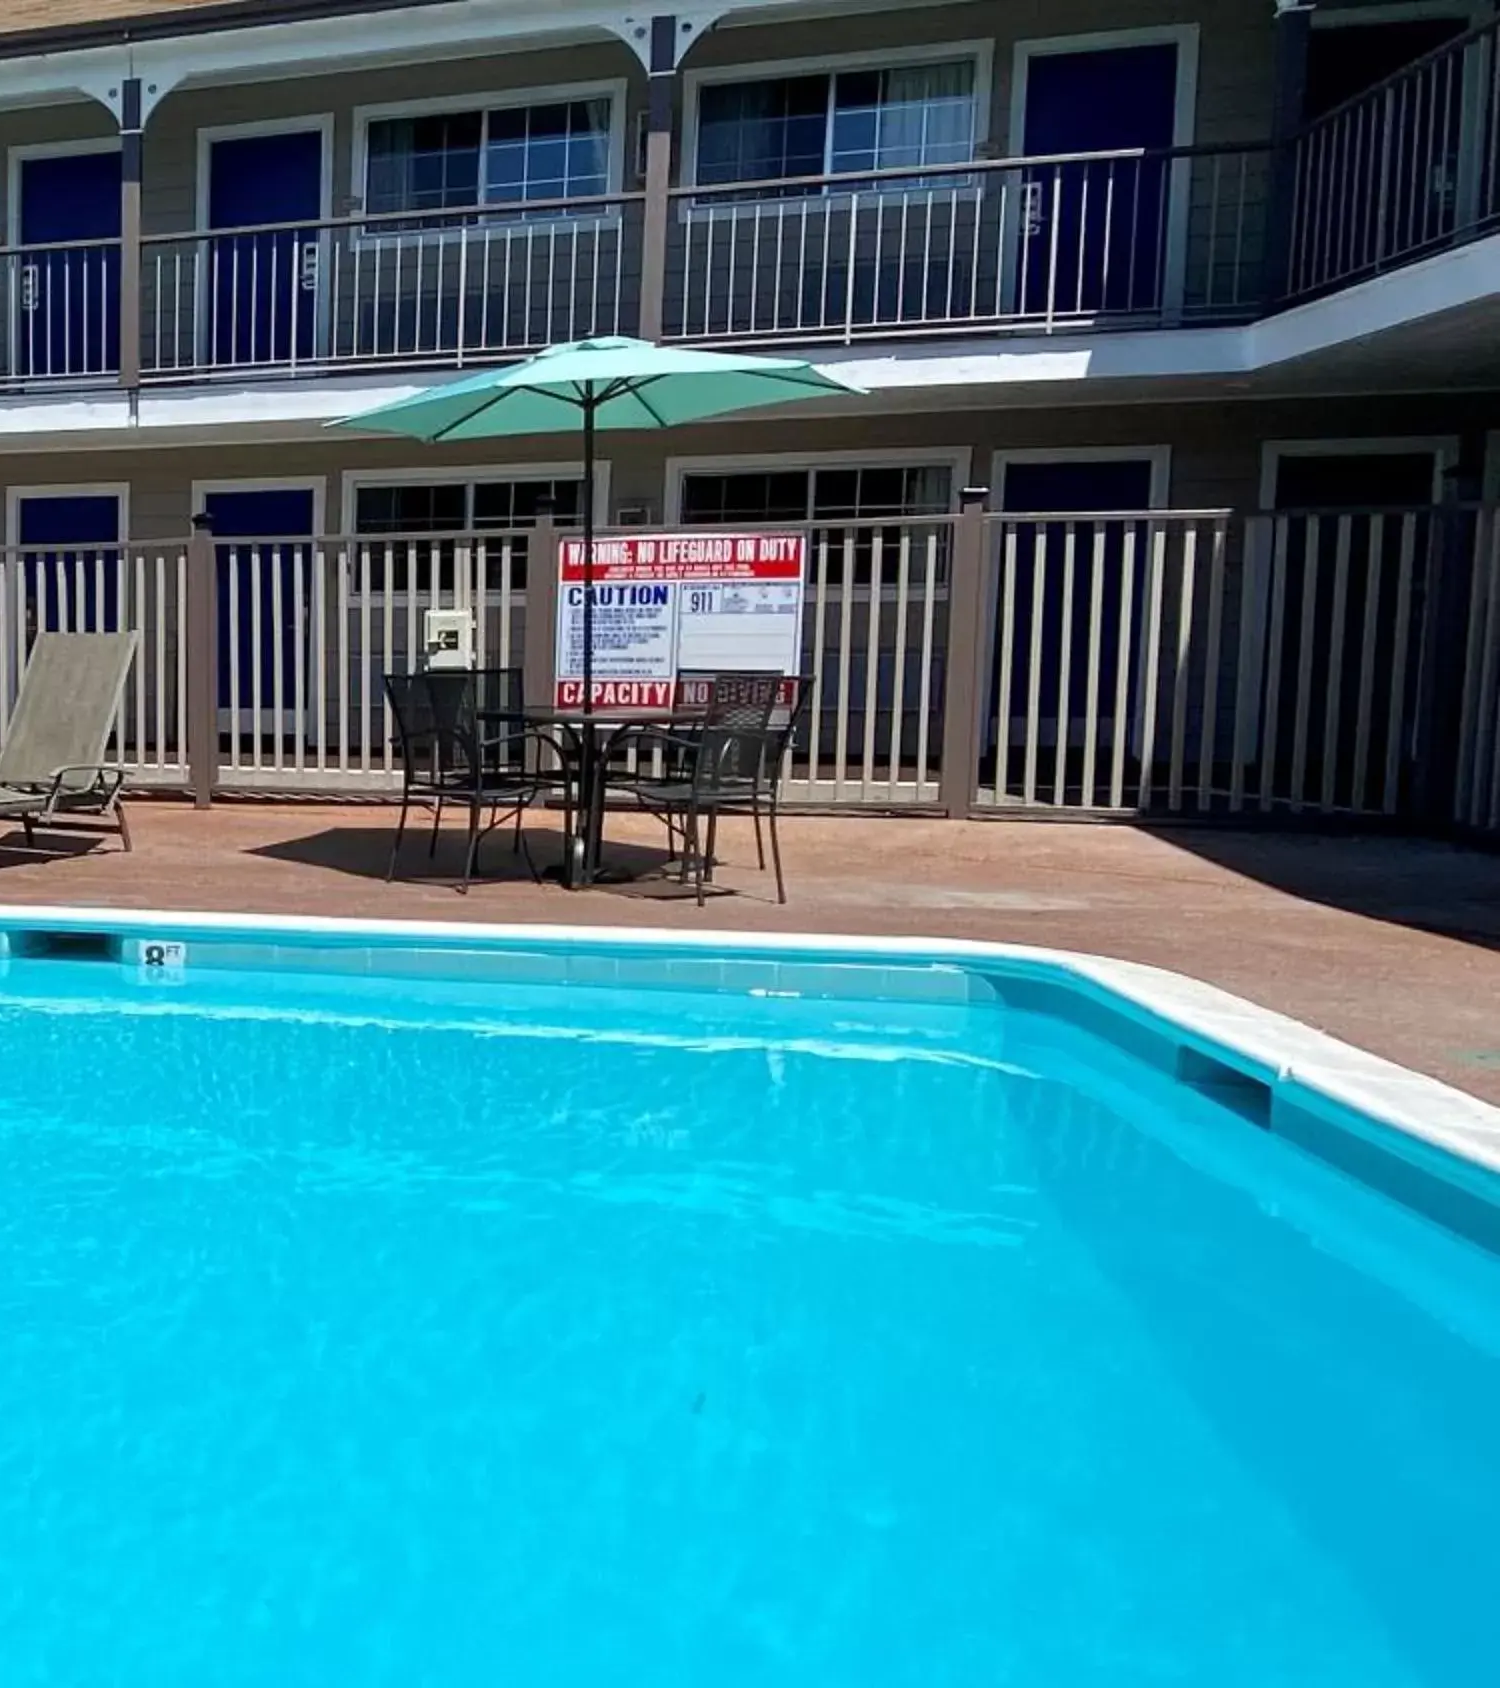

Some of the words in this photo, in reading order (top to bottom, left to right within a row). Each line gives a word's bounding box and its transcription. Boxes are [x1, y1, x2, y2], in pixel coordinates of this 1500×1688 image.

[638, 541, 655, 564] NO
[660, 539, 732, 564] LIFEGUARD
[737, 539, 755, 562] ON
[760, 537, 797, 562] DUTY
[691, 591, 713, 613] 911
[683, 682, 709, 703] NO
